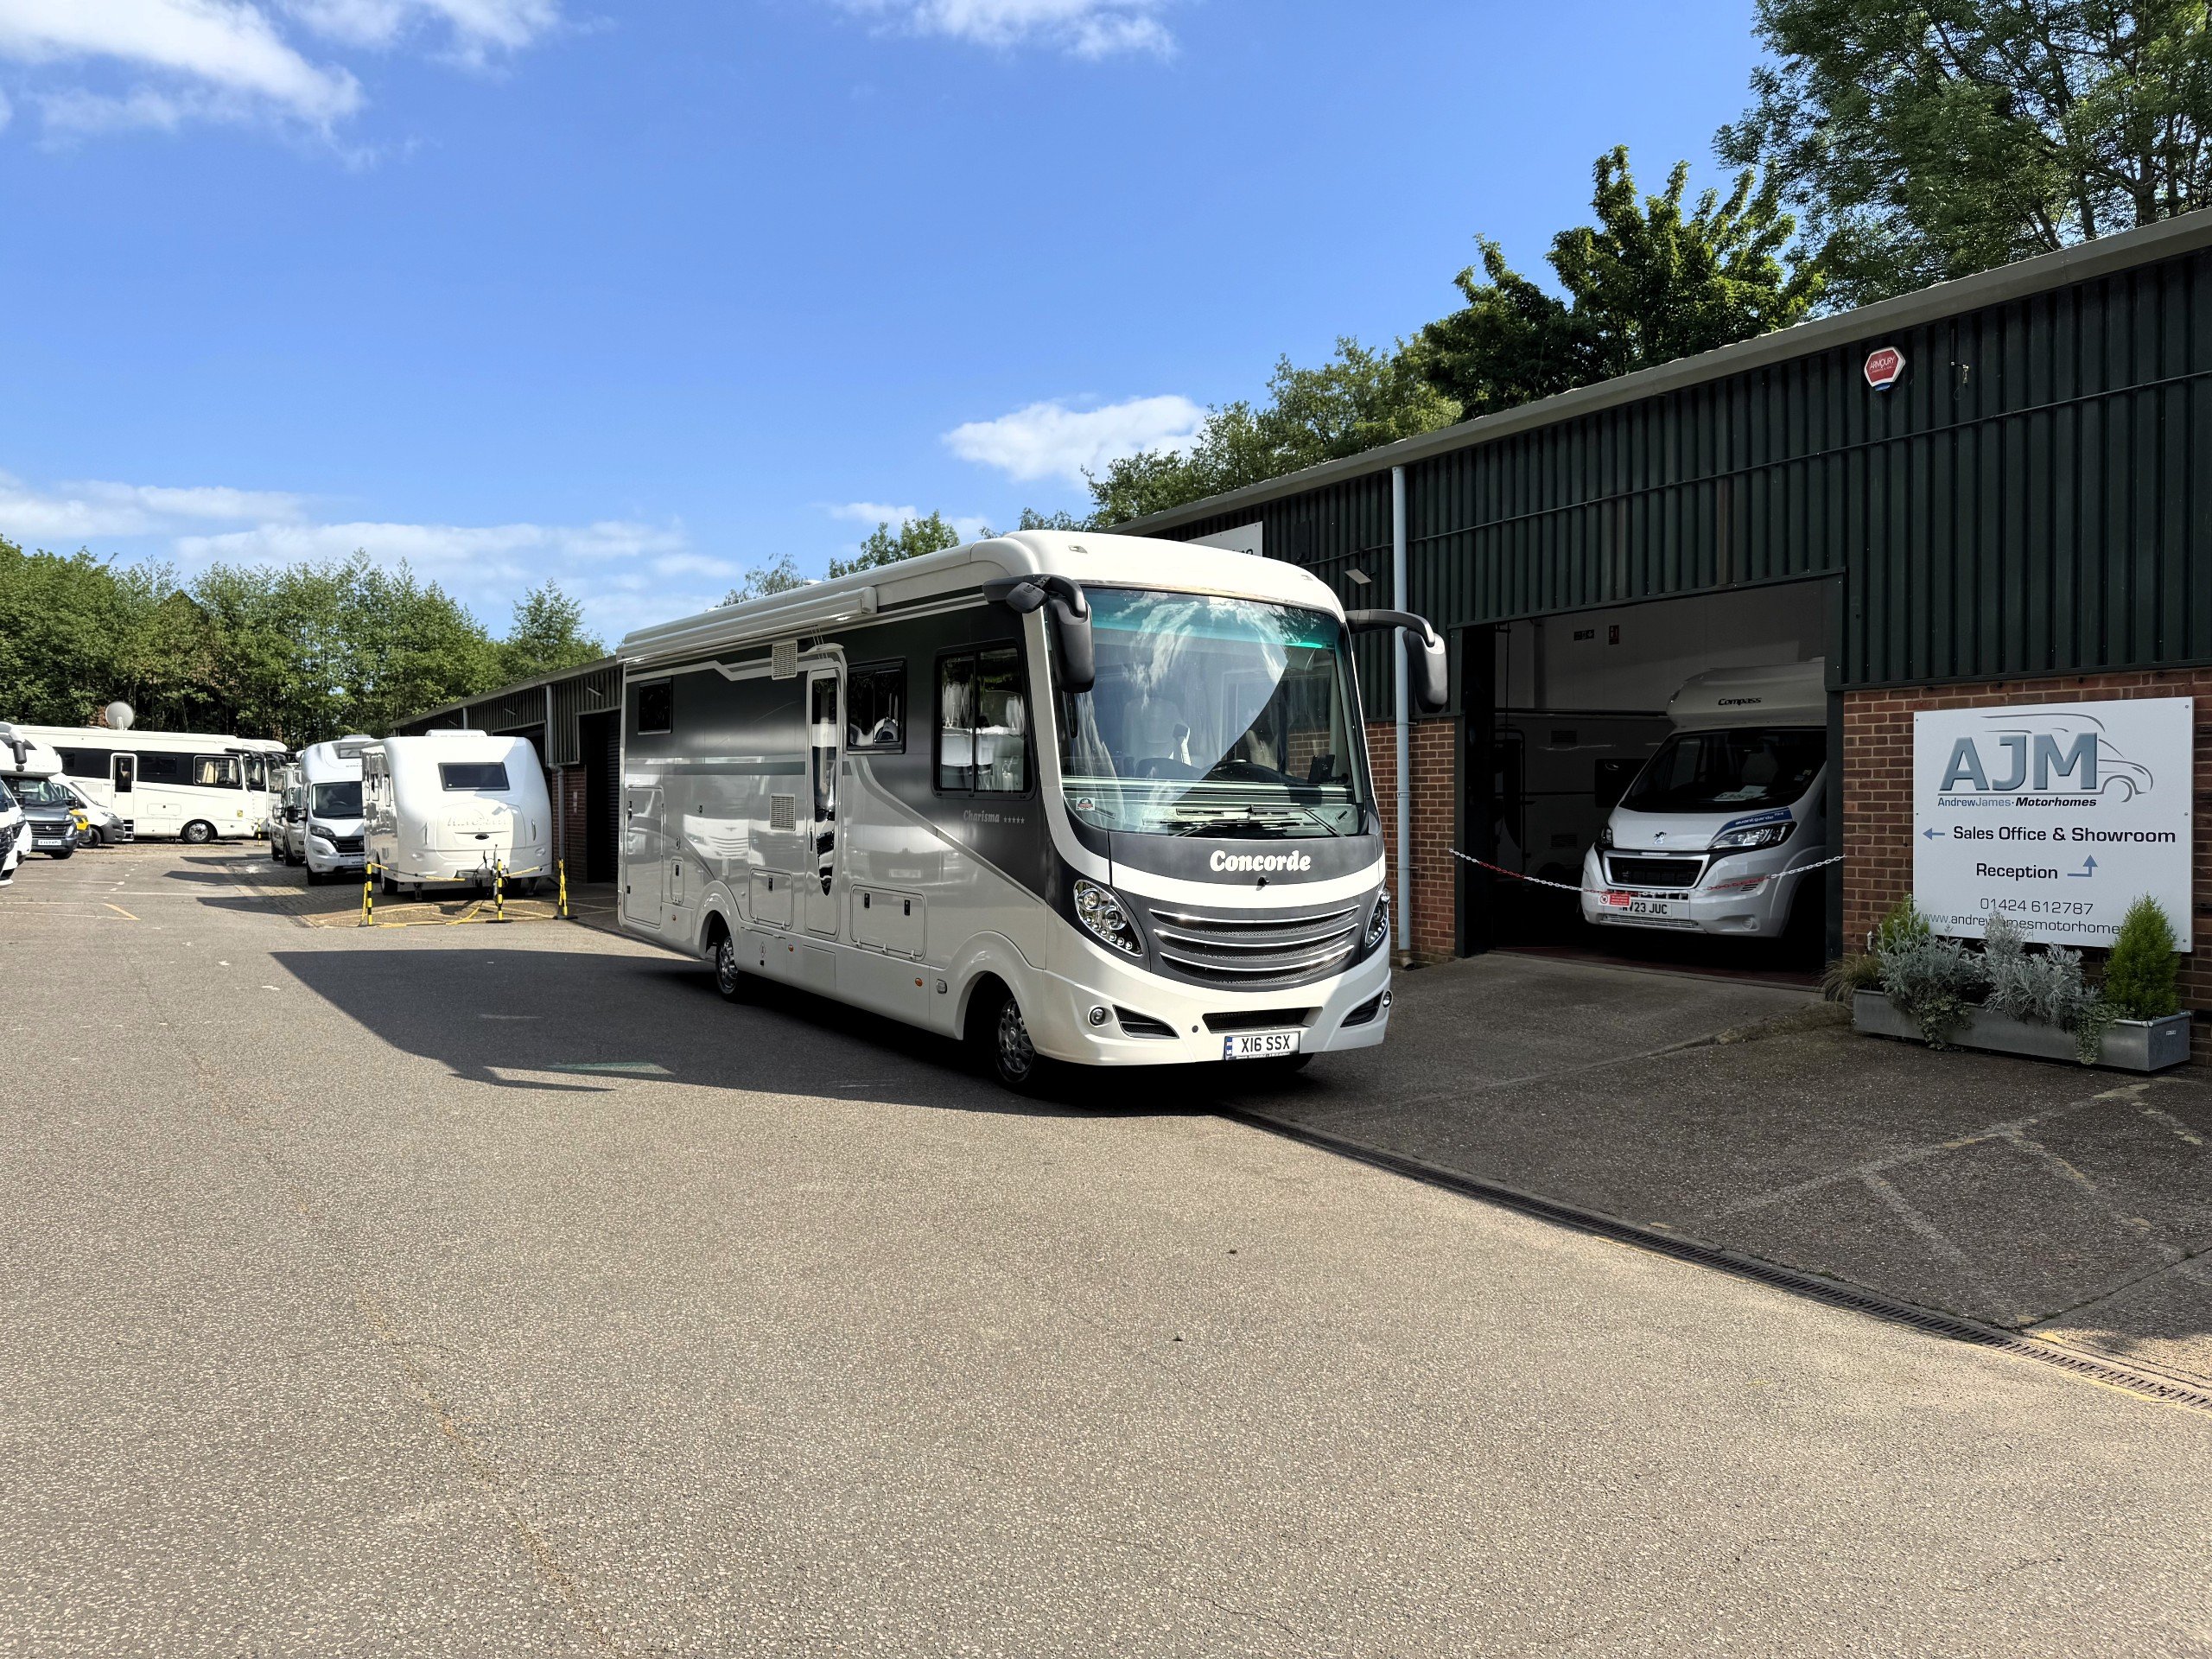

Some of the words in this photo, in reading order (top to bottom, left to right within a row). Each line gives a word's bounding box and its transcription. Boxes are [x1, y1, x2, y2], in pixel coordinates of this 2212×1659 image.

[1870, 357, 1895, 369] ARMOURY
[1718, 697, 1762, 706] Compass
[1939, 732, 2098, 791] AJM
[963, 810, 1000, 823] Charisma
[1954, 825, 1994, 840] Sales
[1999, 826, 2047, 841] Office
[2052, 827, 2066, 842] &
[2071, 827, 2176, 842] Showroom
[1210, 849, 1312, 872] Concorde
[1976, 862, 2058, 881] Reception
[1649, 903, 1668, 914] JUC
[1980, 898, 2027, 912] 01424
[2031, 900, 2094, 915] 612787
[1241, 1037, 1262, 1053] X16
[1266, 1034, 1291, 1051] SSX
